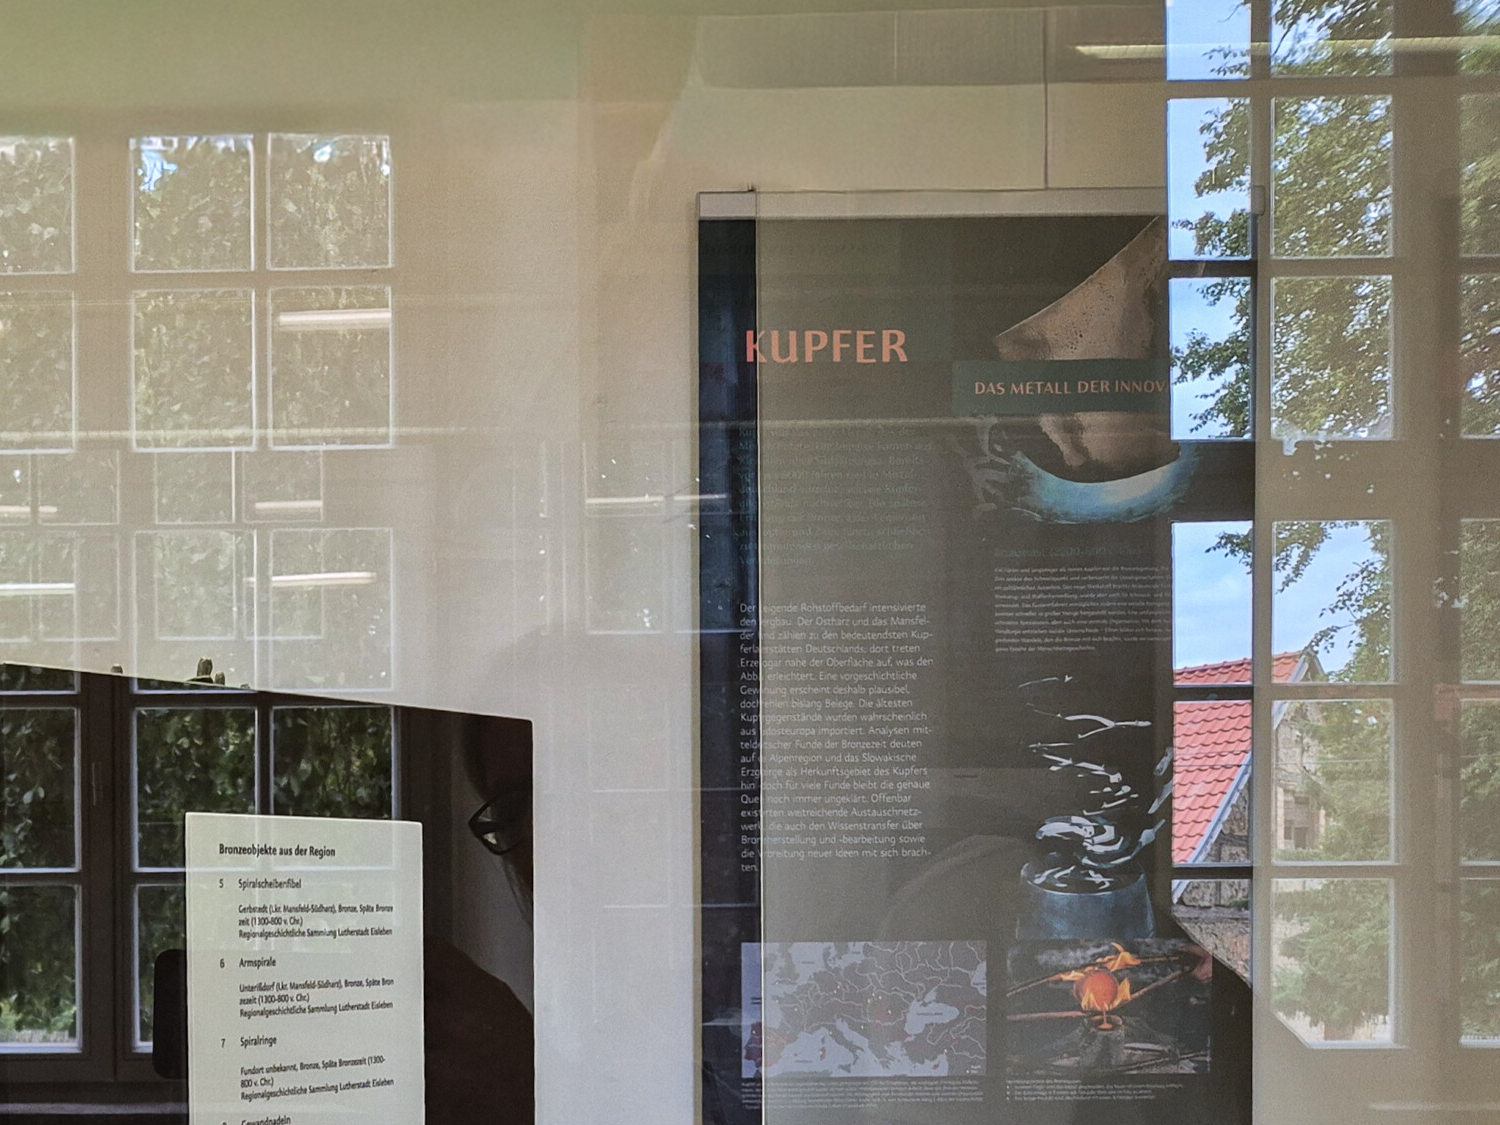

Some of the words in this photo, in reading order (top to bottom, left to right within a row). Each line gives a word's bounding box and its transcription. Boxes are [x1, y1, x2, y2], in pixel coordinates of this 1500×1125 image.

[745, 329, 909, 364] KUPFER
[974, 381, 1006, 396] DAS
[1009, 380, 1072, 396] METALL
[1076, 379, 1111, 394] DER
[796, 616, 813, 626] Der
[815, 616, 850, 626] Ostharz
[851, 617, 870, 626] und
[871, 616, 889, 626] das
[889, 614, 930, 626] Mansfel-
[784, 657, 807, 667] nahe
[808, 657, 824, 667] der
[825, 656, 875, 667] Oberfläche
[876, 655, 893, 667] auf,
[895, 658, 914, 667] was
[916, 656, 934, 666] den
[824, 712, 858, 722] wurden
[859, 711, 927, 721] wahrscheinlich
[794, 738, 823, 749] Funde
[824, 739, 839, 749] der
[841, 739, 887, 749] Bronzezeit
[889, 738, 923, 749] deuten
[785, 766, 797, 777] als
[800, 765, 871, 778] Herkunftsgebiet
[873, 765, 890, 776] des
[892, 765, 929, 777] Kupfers
[768, 821, 782, 831] die
[783, 821, 806, 831] auch
[808, 821, 826, 831] den
[827, 819, 900, 830] Wissenstransfer
[901, 819, 923, 830] über
[218, 843, 277, 856] Bronzeobjekte
[278, 847, 293, 856] aus
[294, 844, 308, 856] der
[308, 845, 336, 859] Region
[218, 877, 224, 889] 5
[237, 878, 302, 890] Spiralscheibenfibel
[238, 917, 250, 926] zeit
[250, 916, 283, 927] (1300-800
[288, 916, 303, 927] Chr.)
[238, 928, 306, 940] Regionalgeschichtliche
[306, 928, 337, 939] Sammlung
[337, 927, 370, 936] Lutherstadt
[370, 927, 393, 936] Eisleben
[219, 958, 225, 969] 6
[238, 956, 276, 969] Armspirale
[220, 1037, 226, 1048] 7
[239, 1035, 277, 1048] Spiralringe
[240, 1065, 265, 1076] Fundort
[265, 1063, 299, 1073] unbekannt,
[299, 1062, 321, 1070] Bronze,
[321, 1059, 338, 1070] Späte
[338, 1057, 367, 1067] Bronzezeit
[367, 1055, 386, 1066] (1300-
[240, 1078, 253, 1088] 800
[259, 1076, 274, 1087] Chr.)
